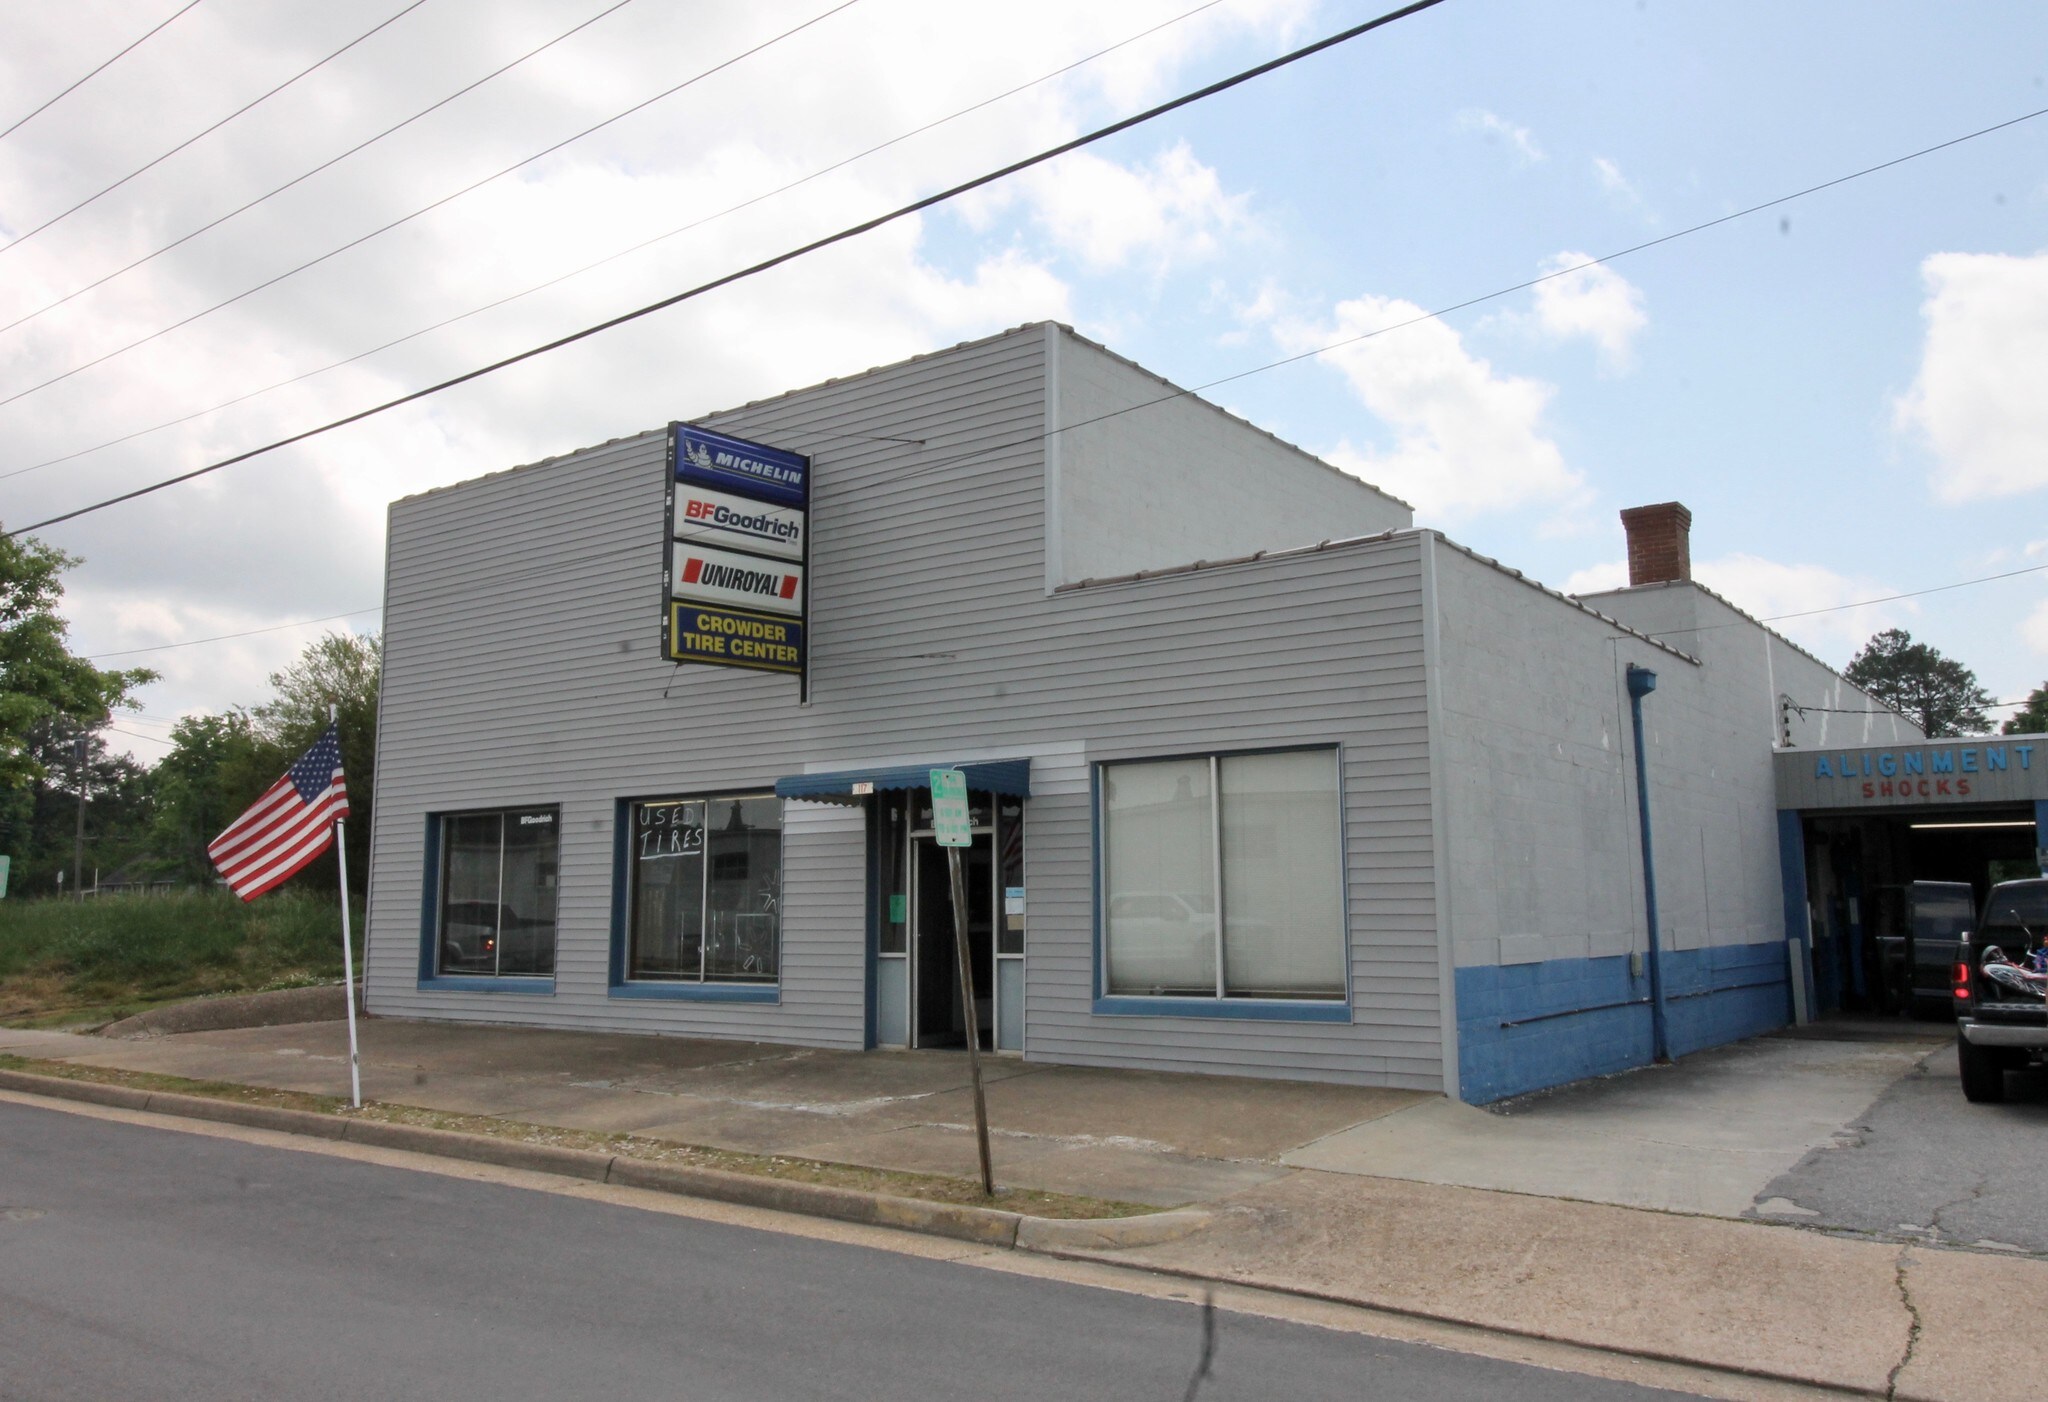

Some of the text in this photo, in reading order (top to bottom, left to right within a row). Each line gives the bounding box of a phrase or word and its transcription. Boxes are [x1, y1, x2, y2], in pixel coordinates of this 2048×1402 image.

[716, 452, 802, 484] MICHELIN
[685, 500, 799, 539] BFGoodrich
[701, 564, 778, 597] UNIROYAL
[697, 614, 786, 642] CROWDER
[683, 633, 798, 662] TIRE CENTER
[1815, 746, 2034, 778] ALIGNMENT
[1862, 779, 1971, 798] SHOCKS
[640, 807, 694, 825] USED
